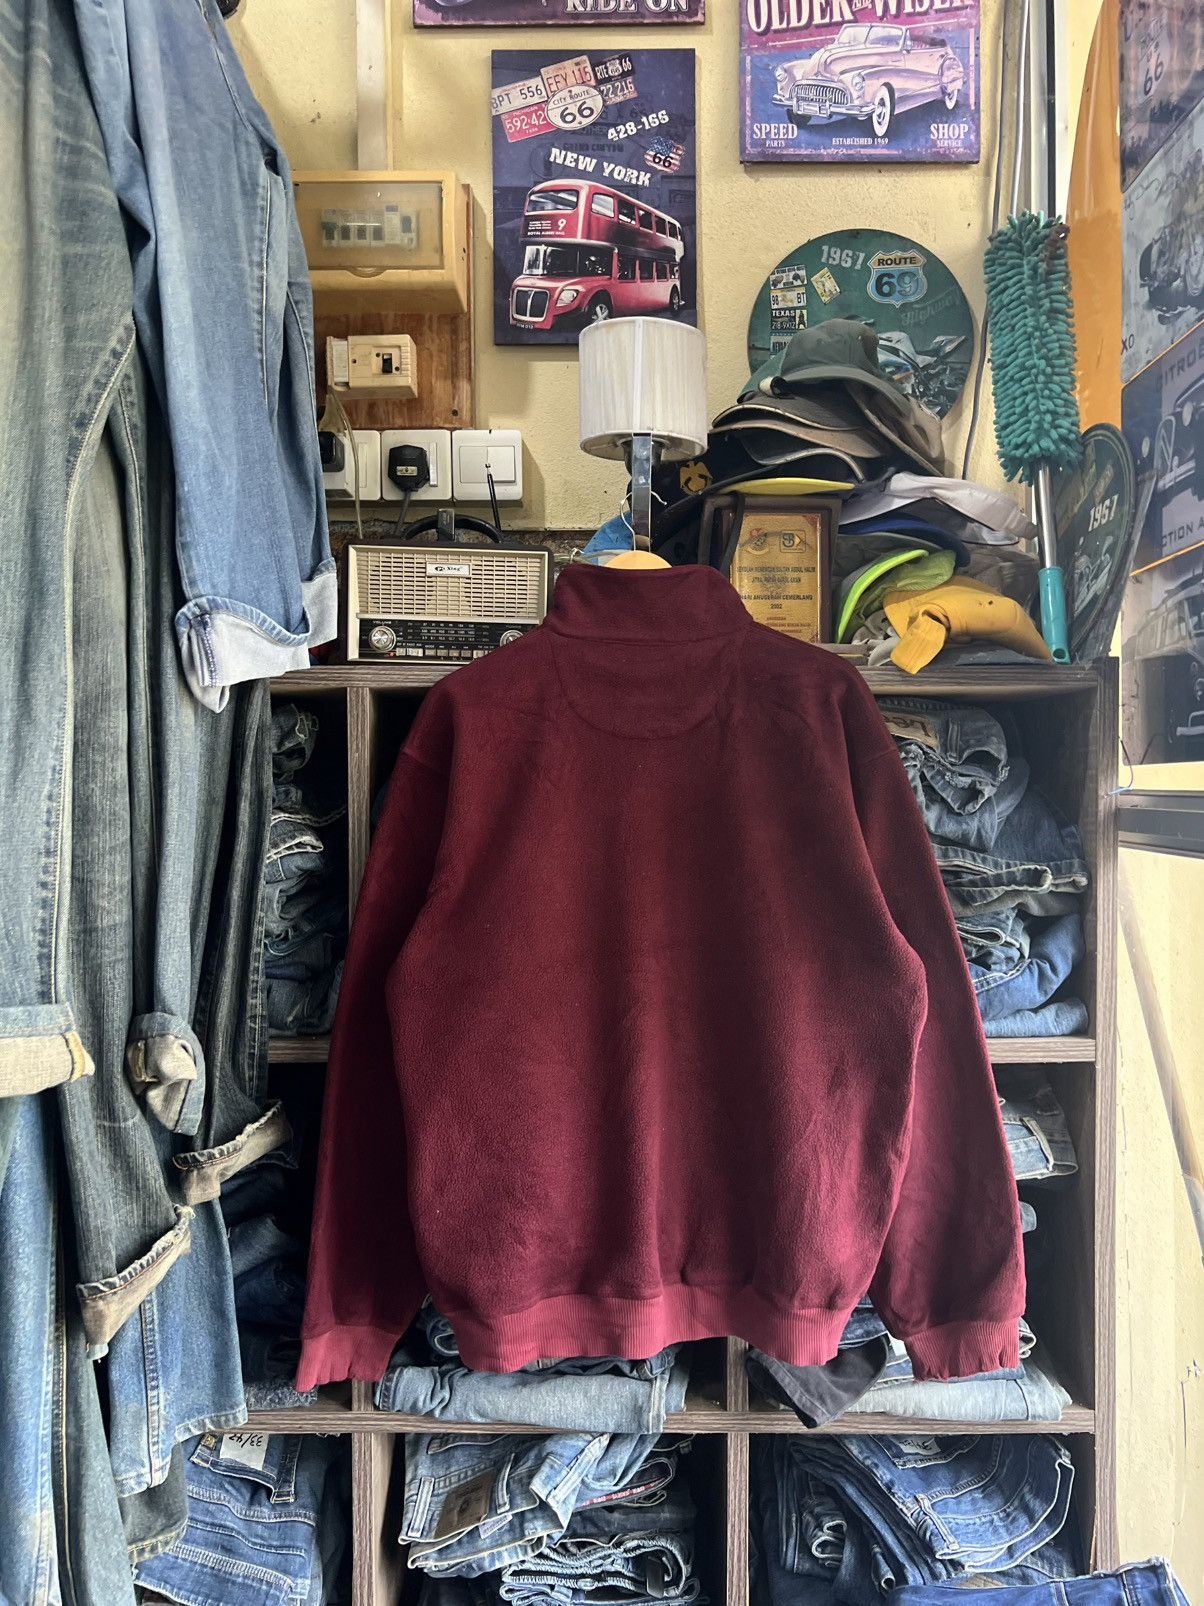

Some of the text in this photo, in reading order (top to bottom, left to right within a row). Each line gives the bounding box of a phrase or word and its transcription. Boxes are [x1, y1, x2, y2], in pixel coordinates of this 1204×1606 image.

[519, 84, 543, 101] 556
[559, 100, 595, 124] 66
[607, 110, 669, 142] 428-166
[753, 123, 798, 140] SPEED
[930, 123, 969, 140] SHOP
[766, 140, 786, 148] PARTS
[832, 137, 889, 146] ESTABLISHED 1969
[549, 147, 652, 187] NEW YORK
[652, 153, 674, 168] 66
[558, 218, 567, 230] 9
[821, 245, 865, 270] 1967
[877, 256, 917, 267] ROUTE
[772, 309, 796, 317] TEXAS
[1088, 494, 1119, 532] 1967
